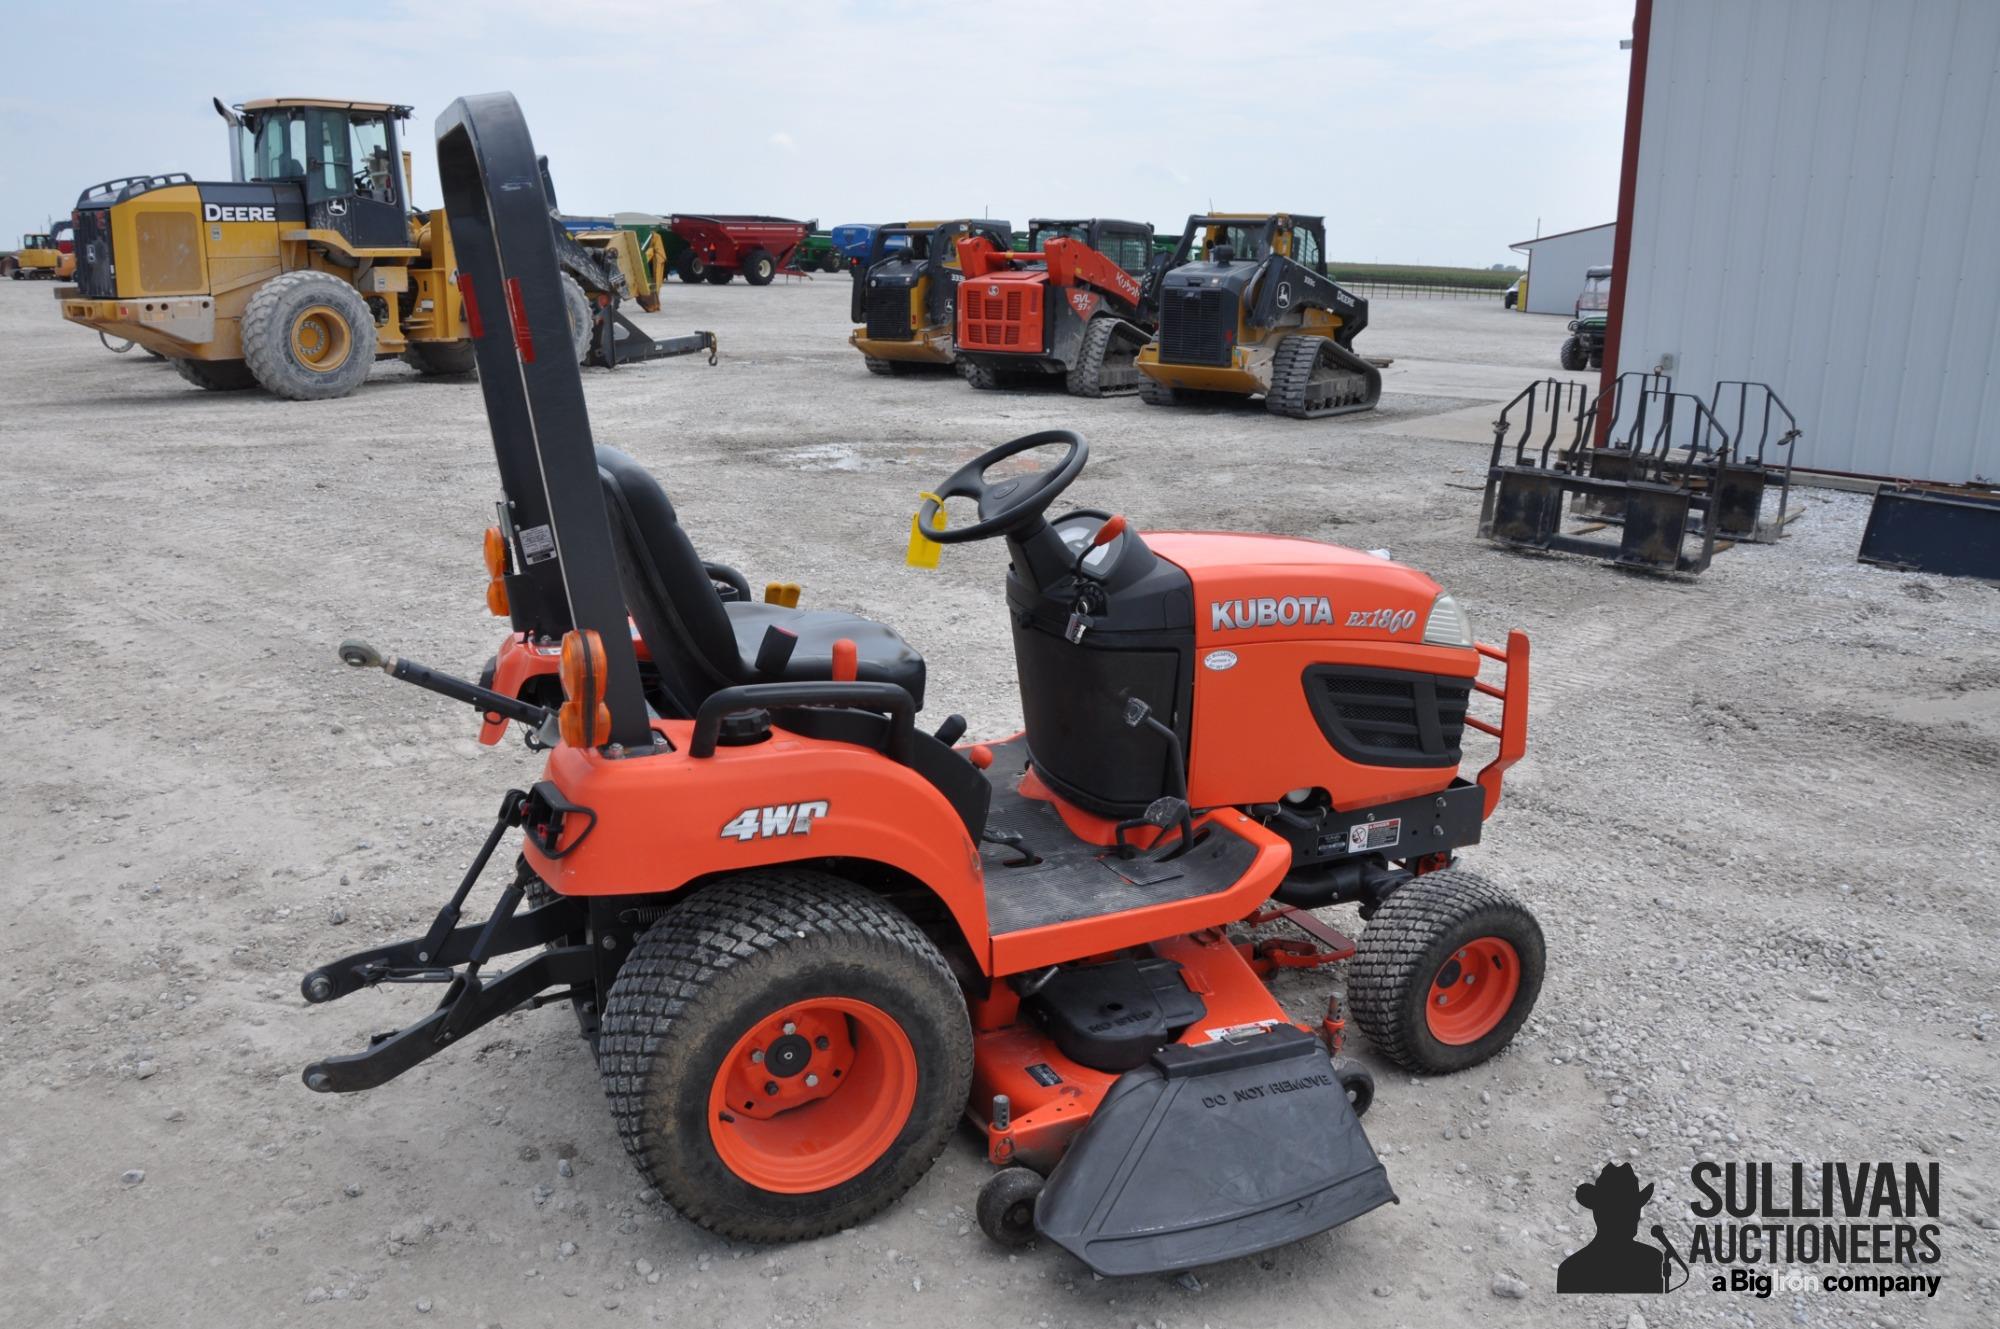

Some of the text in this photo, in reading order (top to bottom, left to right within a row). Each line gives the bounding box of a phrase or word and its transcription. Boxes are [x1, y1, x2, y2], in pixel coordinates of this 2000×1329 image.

[204, 203, 276, 222] DEERE
[1072, 293, 1091, 303] SVL
[1336, 289, 1356, 308] DEERE
[1211, 597, 1416, 634] KUBOTA BX1860
[1201, 1074, 1333, 1109] DO NOT REMOVE
